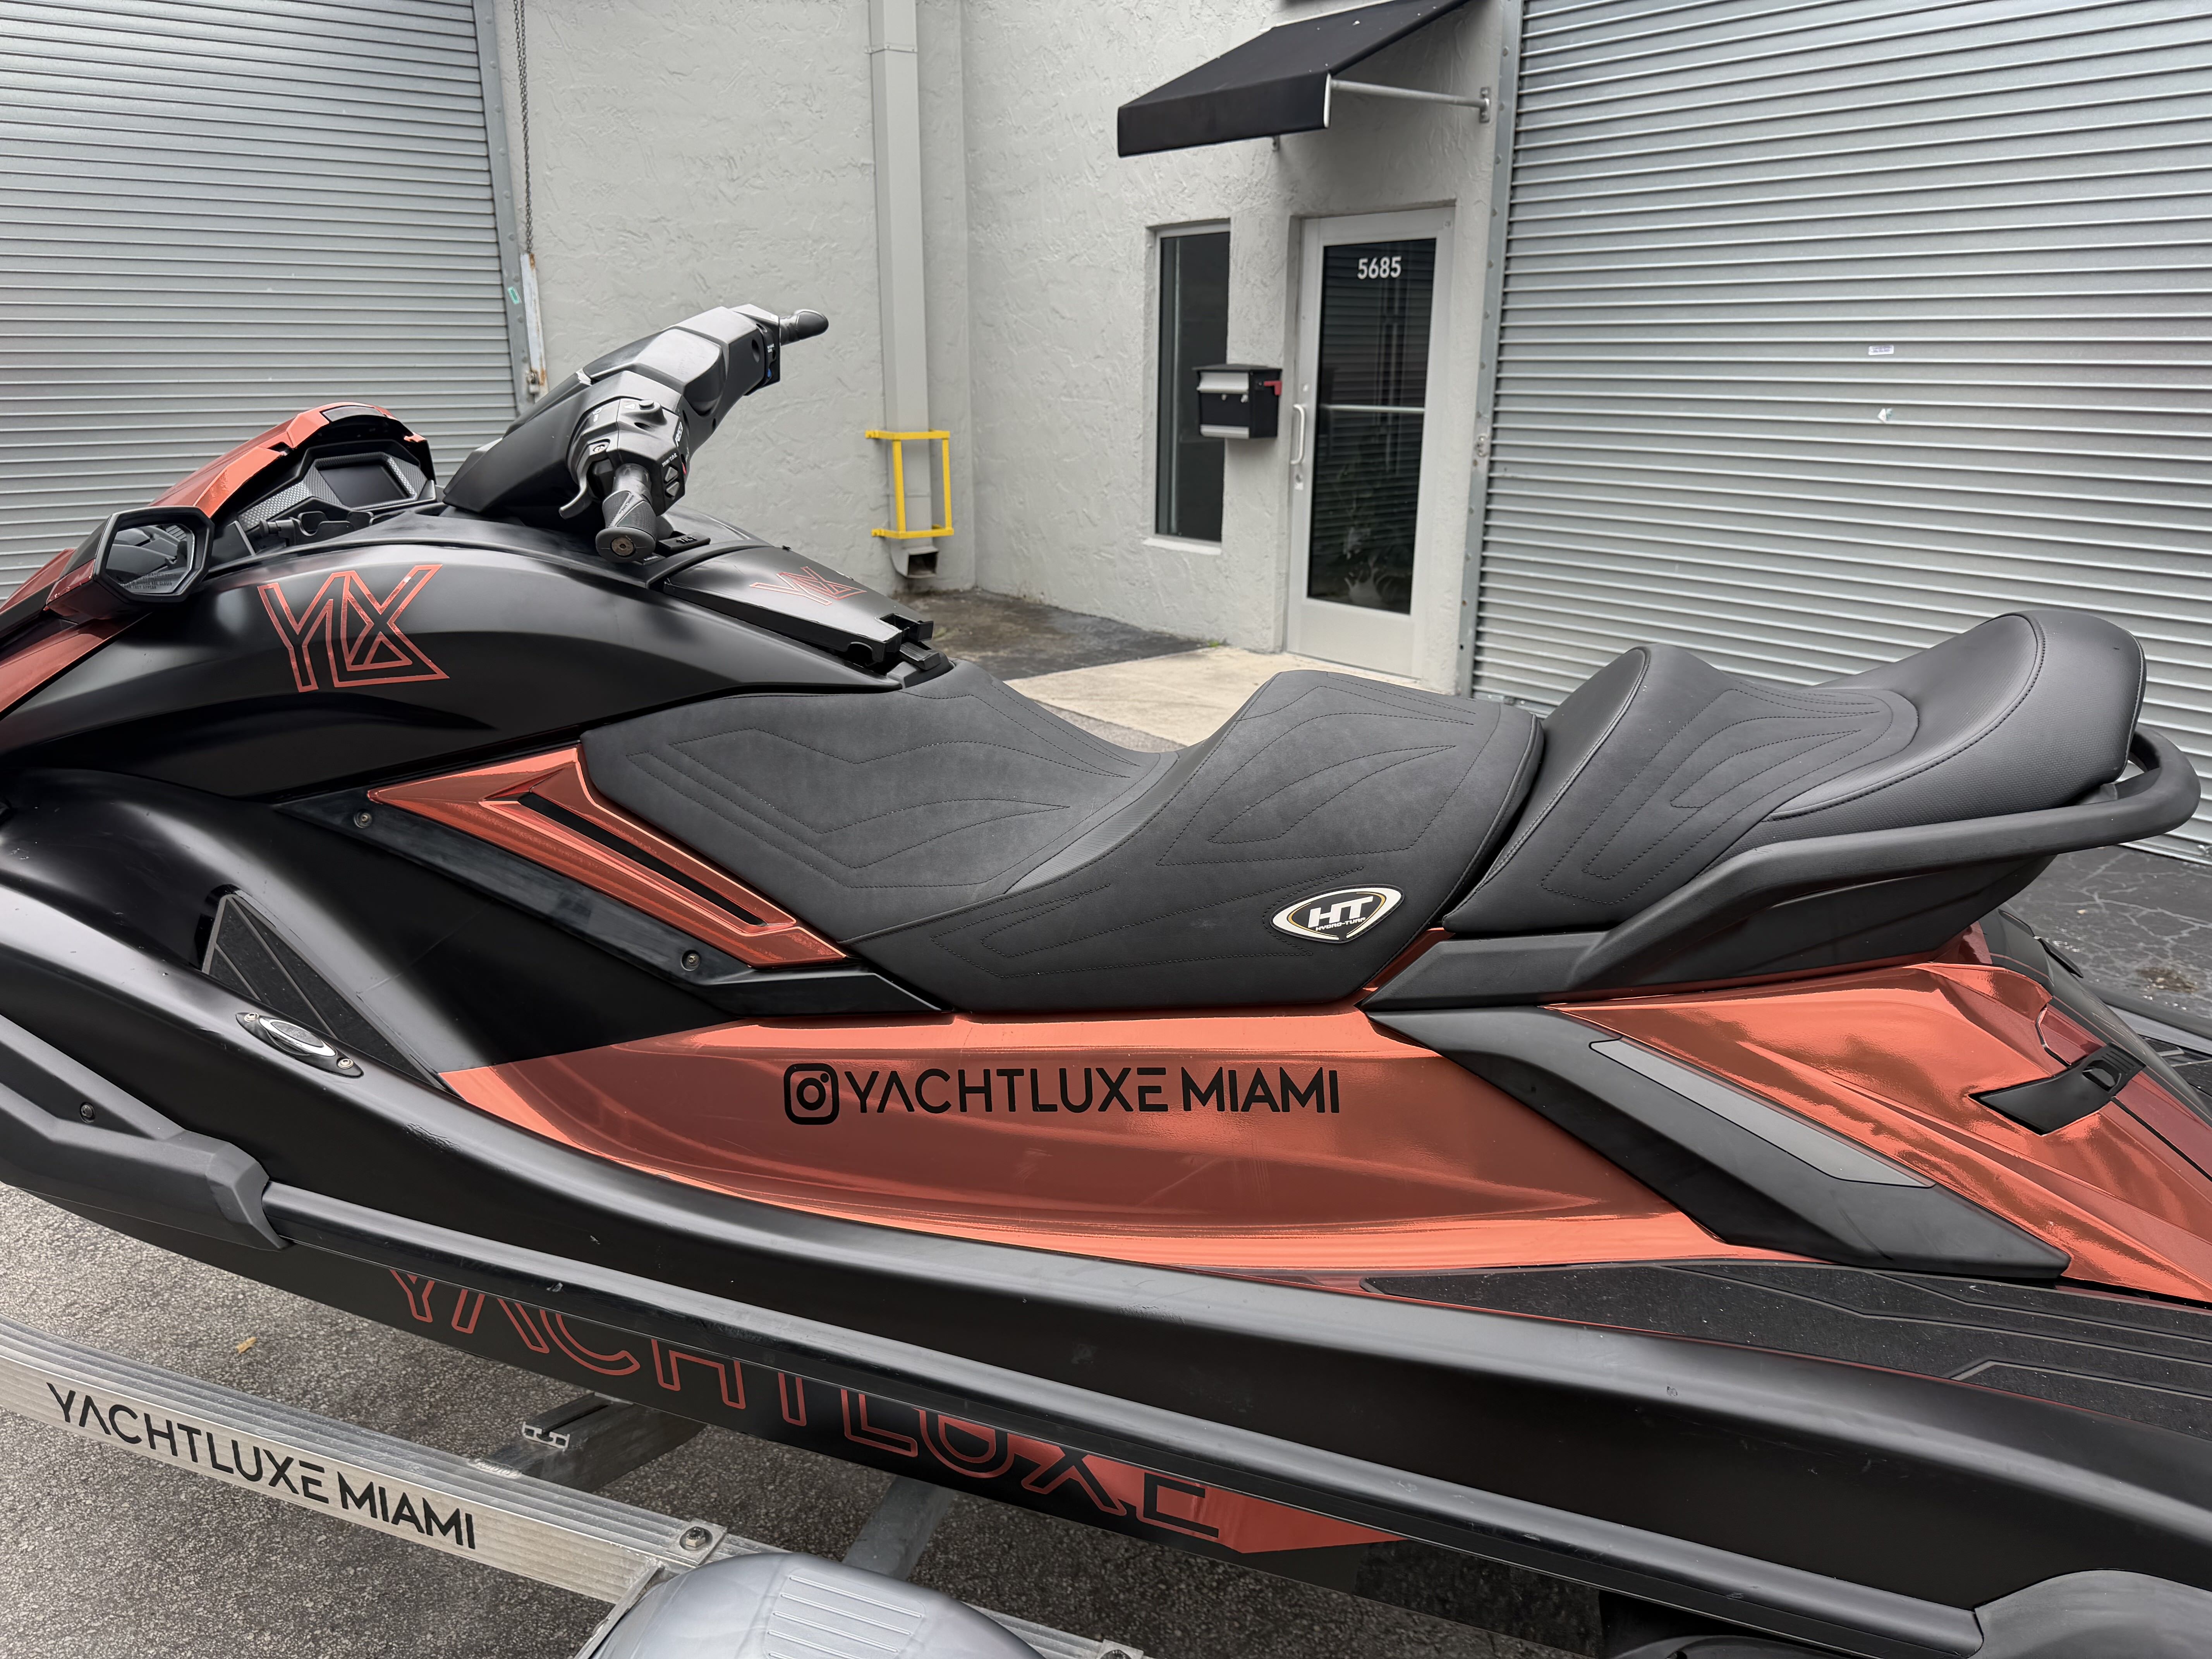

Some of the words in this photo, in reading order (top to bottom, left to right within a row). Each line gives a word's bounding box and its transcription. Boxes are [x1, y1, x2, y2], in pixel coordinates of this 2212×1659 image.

[1357, 255, 1402, 280] 5685
[1308, 896, 1374, 928] HT
[844, 1067, 1168, 1114] YACHTLUXE
[1181, 1066, 1340, 1113] MIAMI
[46, 1382, 329, 1504] YACHTLUXE
[338, 1472, 476, 1549] MIAMI
